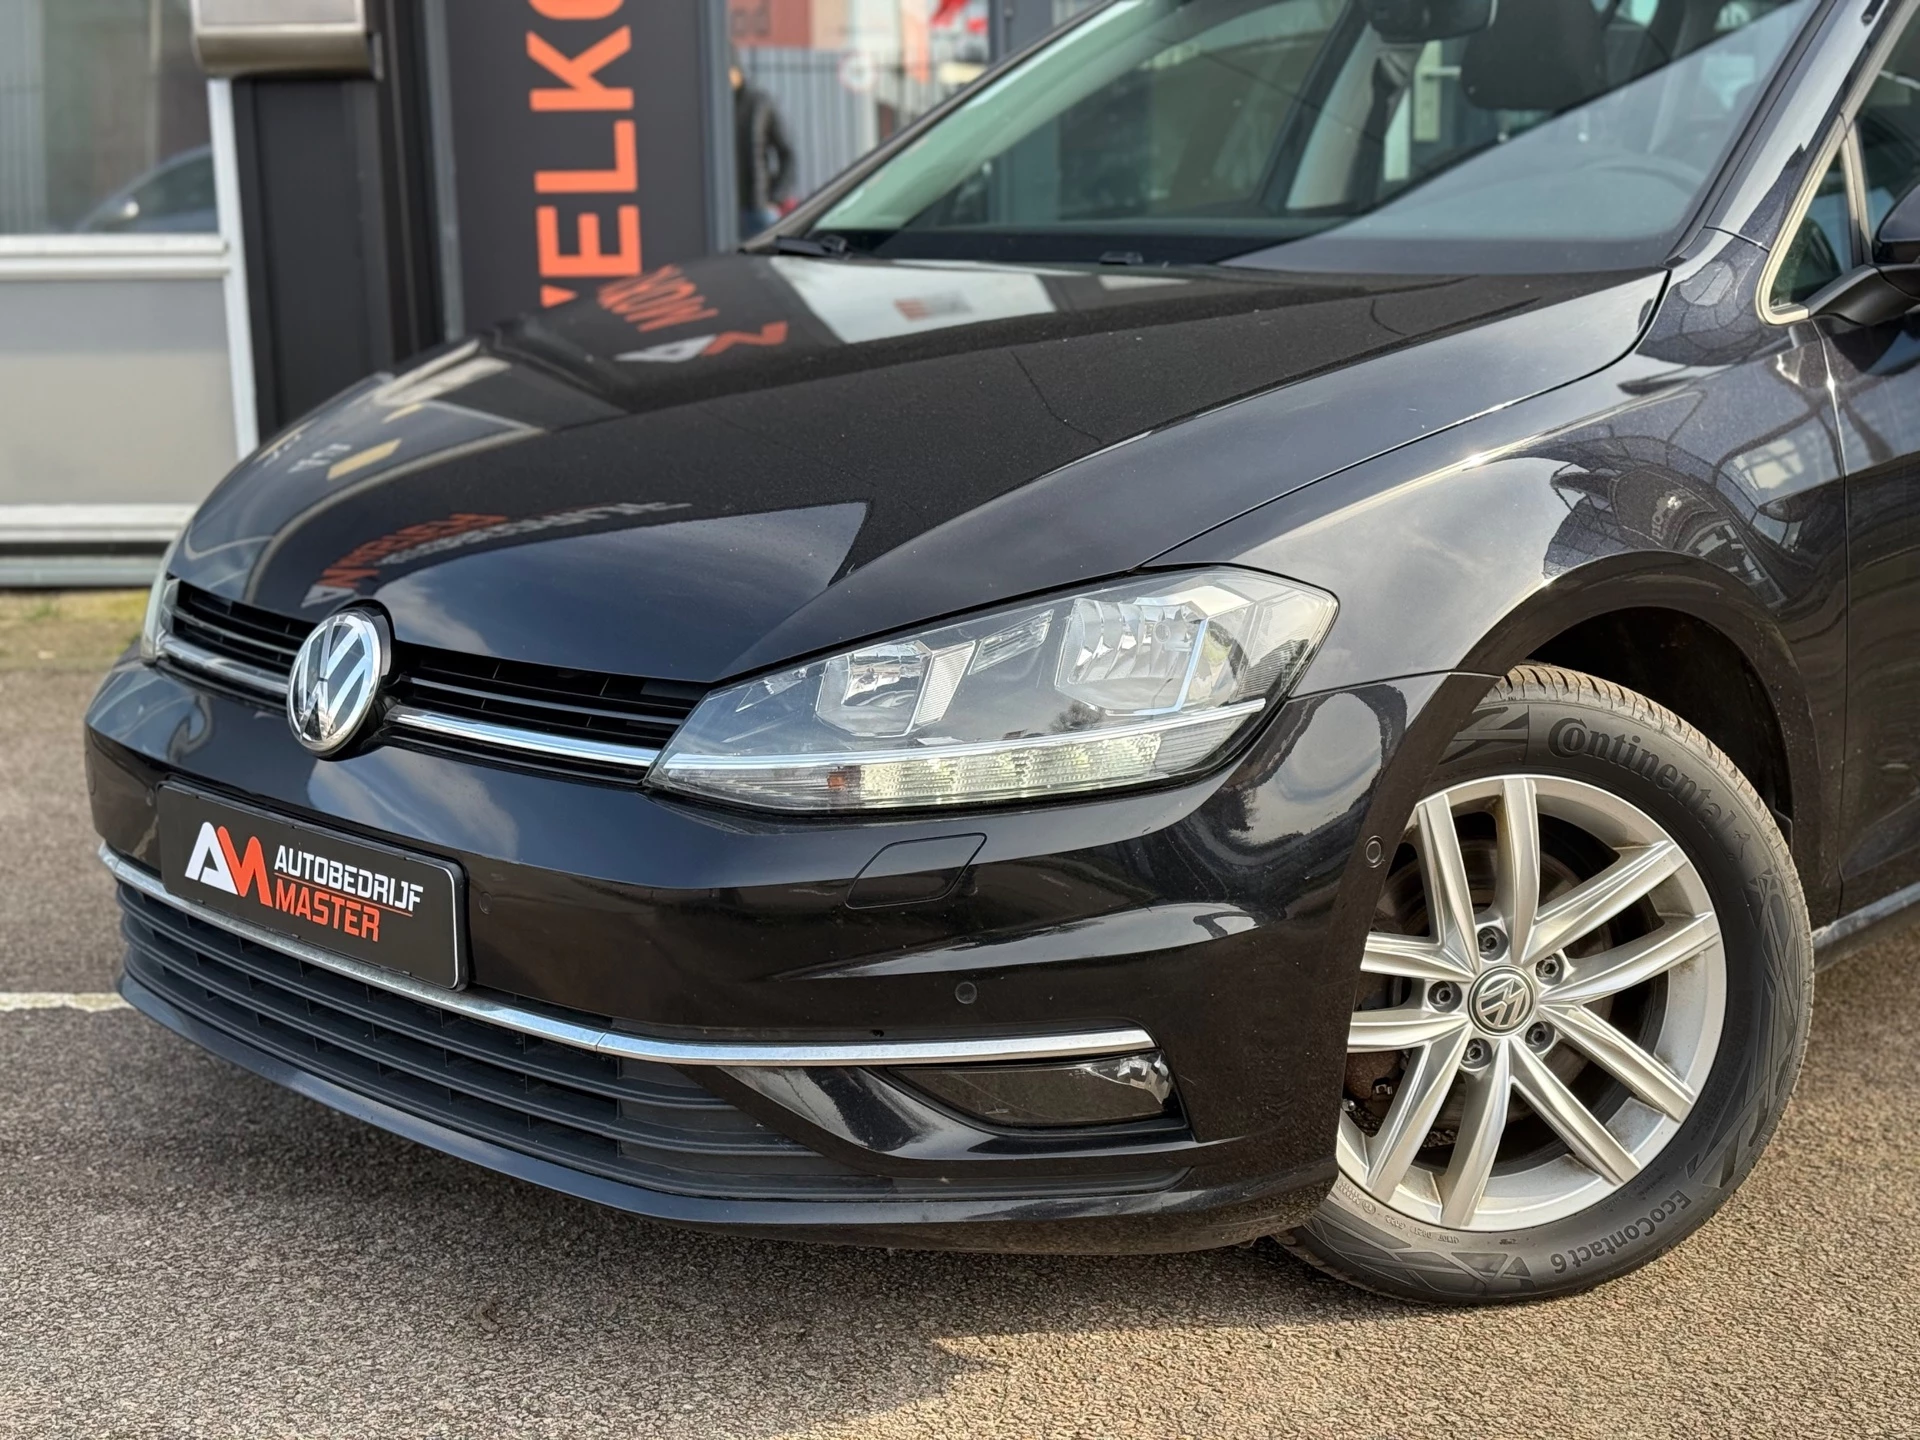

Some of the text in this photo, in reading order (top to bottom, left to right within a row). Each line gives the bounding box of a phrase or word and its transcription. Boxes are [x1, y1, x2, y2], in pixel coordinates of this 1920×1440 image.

[526, 0, 642, 308] ELK
[1548, 717, 1739, 842] Continental
[274, 845, 424, 912] AUTOBEDRIJF
[275, 879, 380, 942] MASTER
[1568, 1190, 1692, 1268] EcoContact
